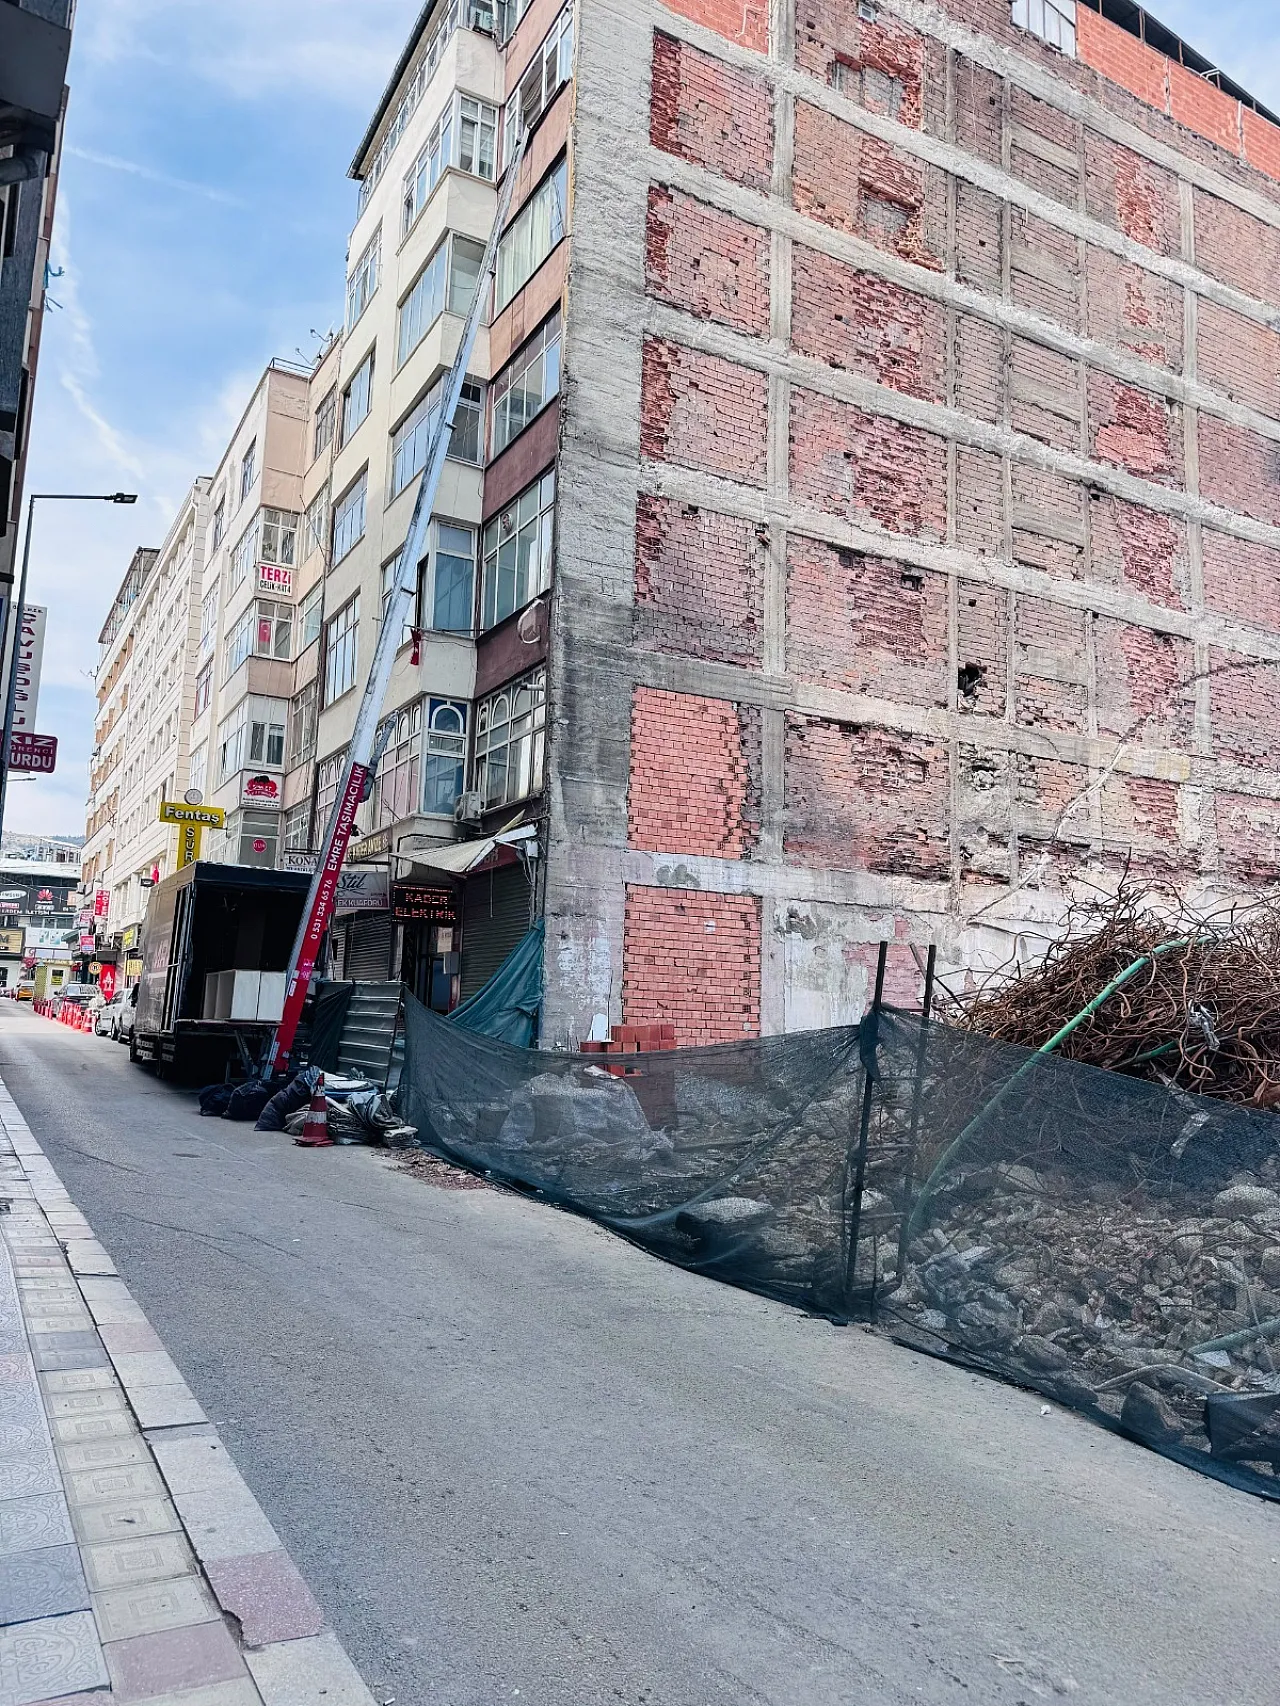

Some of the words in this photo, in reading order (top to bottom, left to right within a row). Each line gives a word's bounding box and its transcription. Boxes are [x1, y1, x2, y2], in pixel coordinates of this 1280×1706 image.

[11, 752, 52, 768] URDU
[165, 805, 220, 825] Fentaş
[327, 839, 344, 872] EMRE
[337, 766, 365, 836] TAŞIMACILIK
[185, 826, 195, 863] SÜR
[288, 855, 318, 867] KONA
[312, 918, 322, 934] 531
